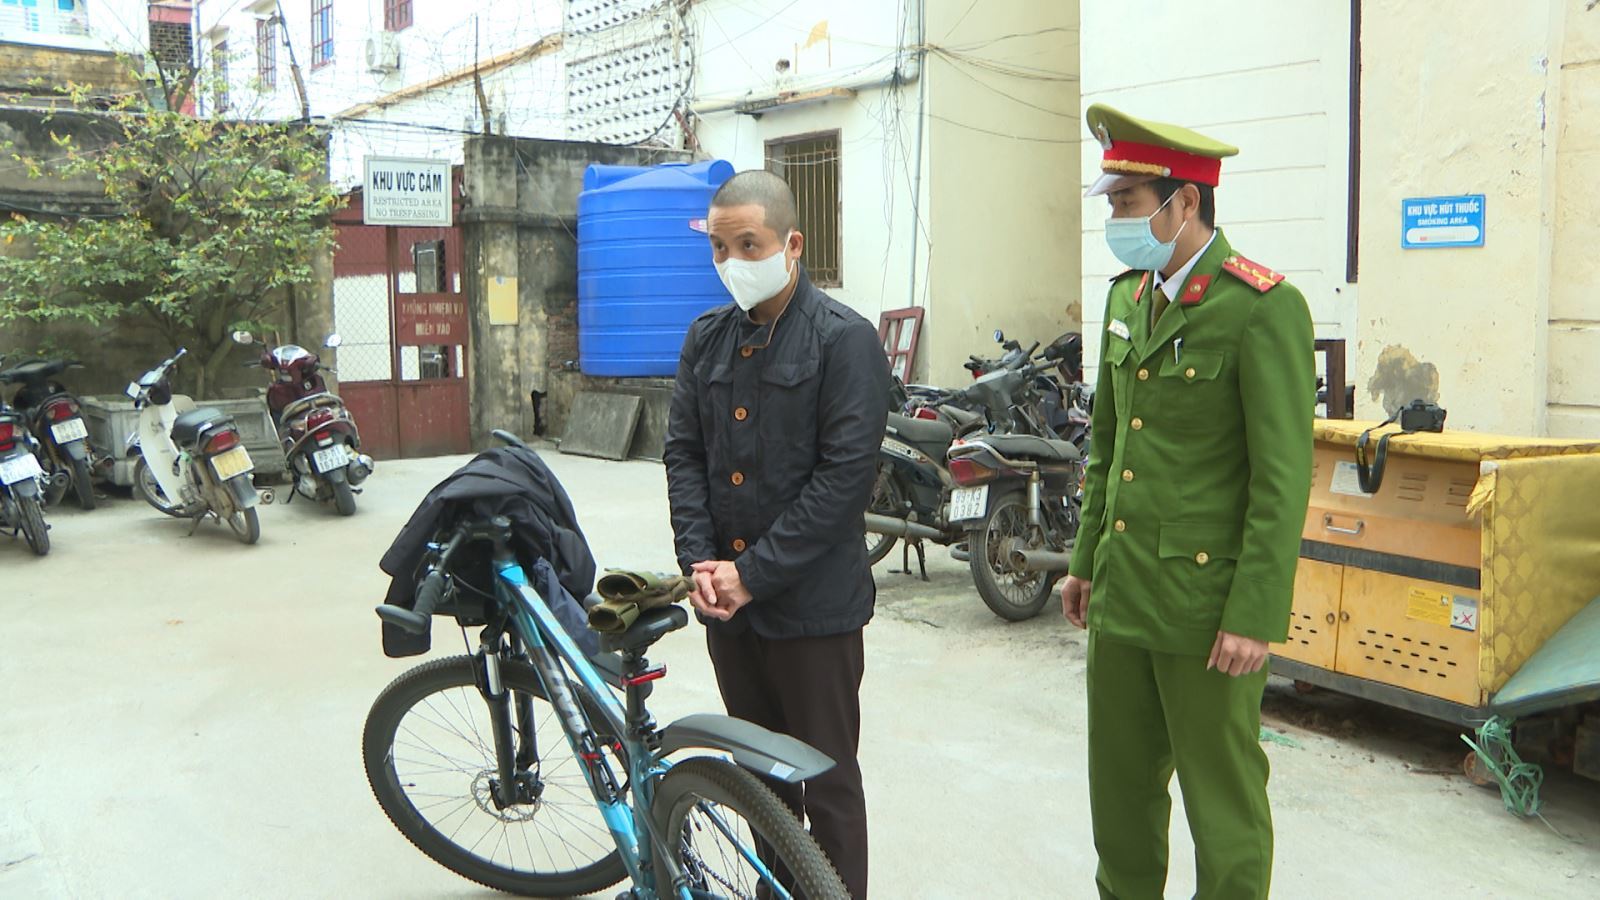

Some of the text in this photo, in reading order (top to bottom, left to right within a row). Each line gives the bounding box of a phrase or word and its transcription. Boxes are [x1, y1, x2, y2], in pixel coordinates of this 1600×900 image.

[373, 171, 392, 190] KHU
[396, 170, 415, 195] VỰC
[373, 196, 442, 207] RESTRICTED AREA
[376, 208, 440, 218] NO TRESPASSING
[1407, 205, 1422, 216] KHU
[1439, 201, 1453, 214] HÚT
[1418, 216, 1468, 226] SMOKING AREA
